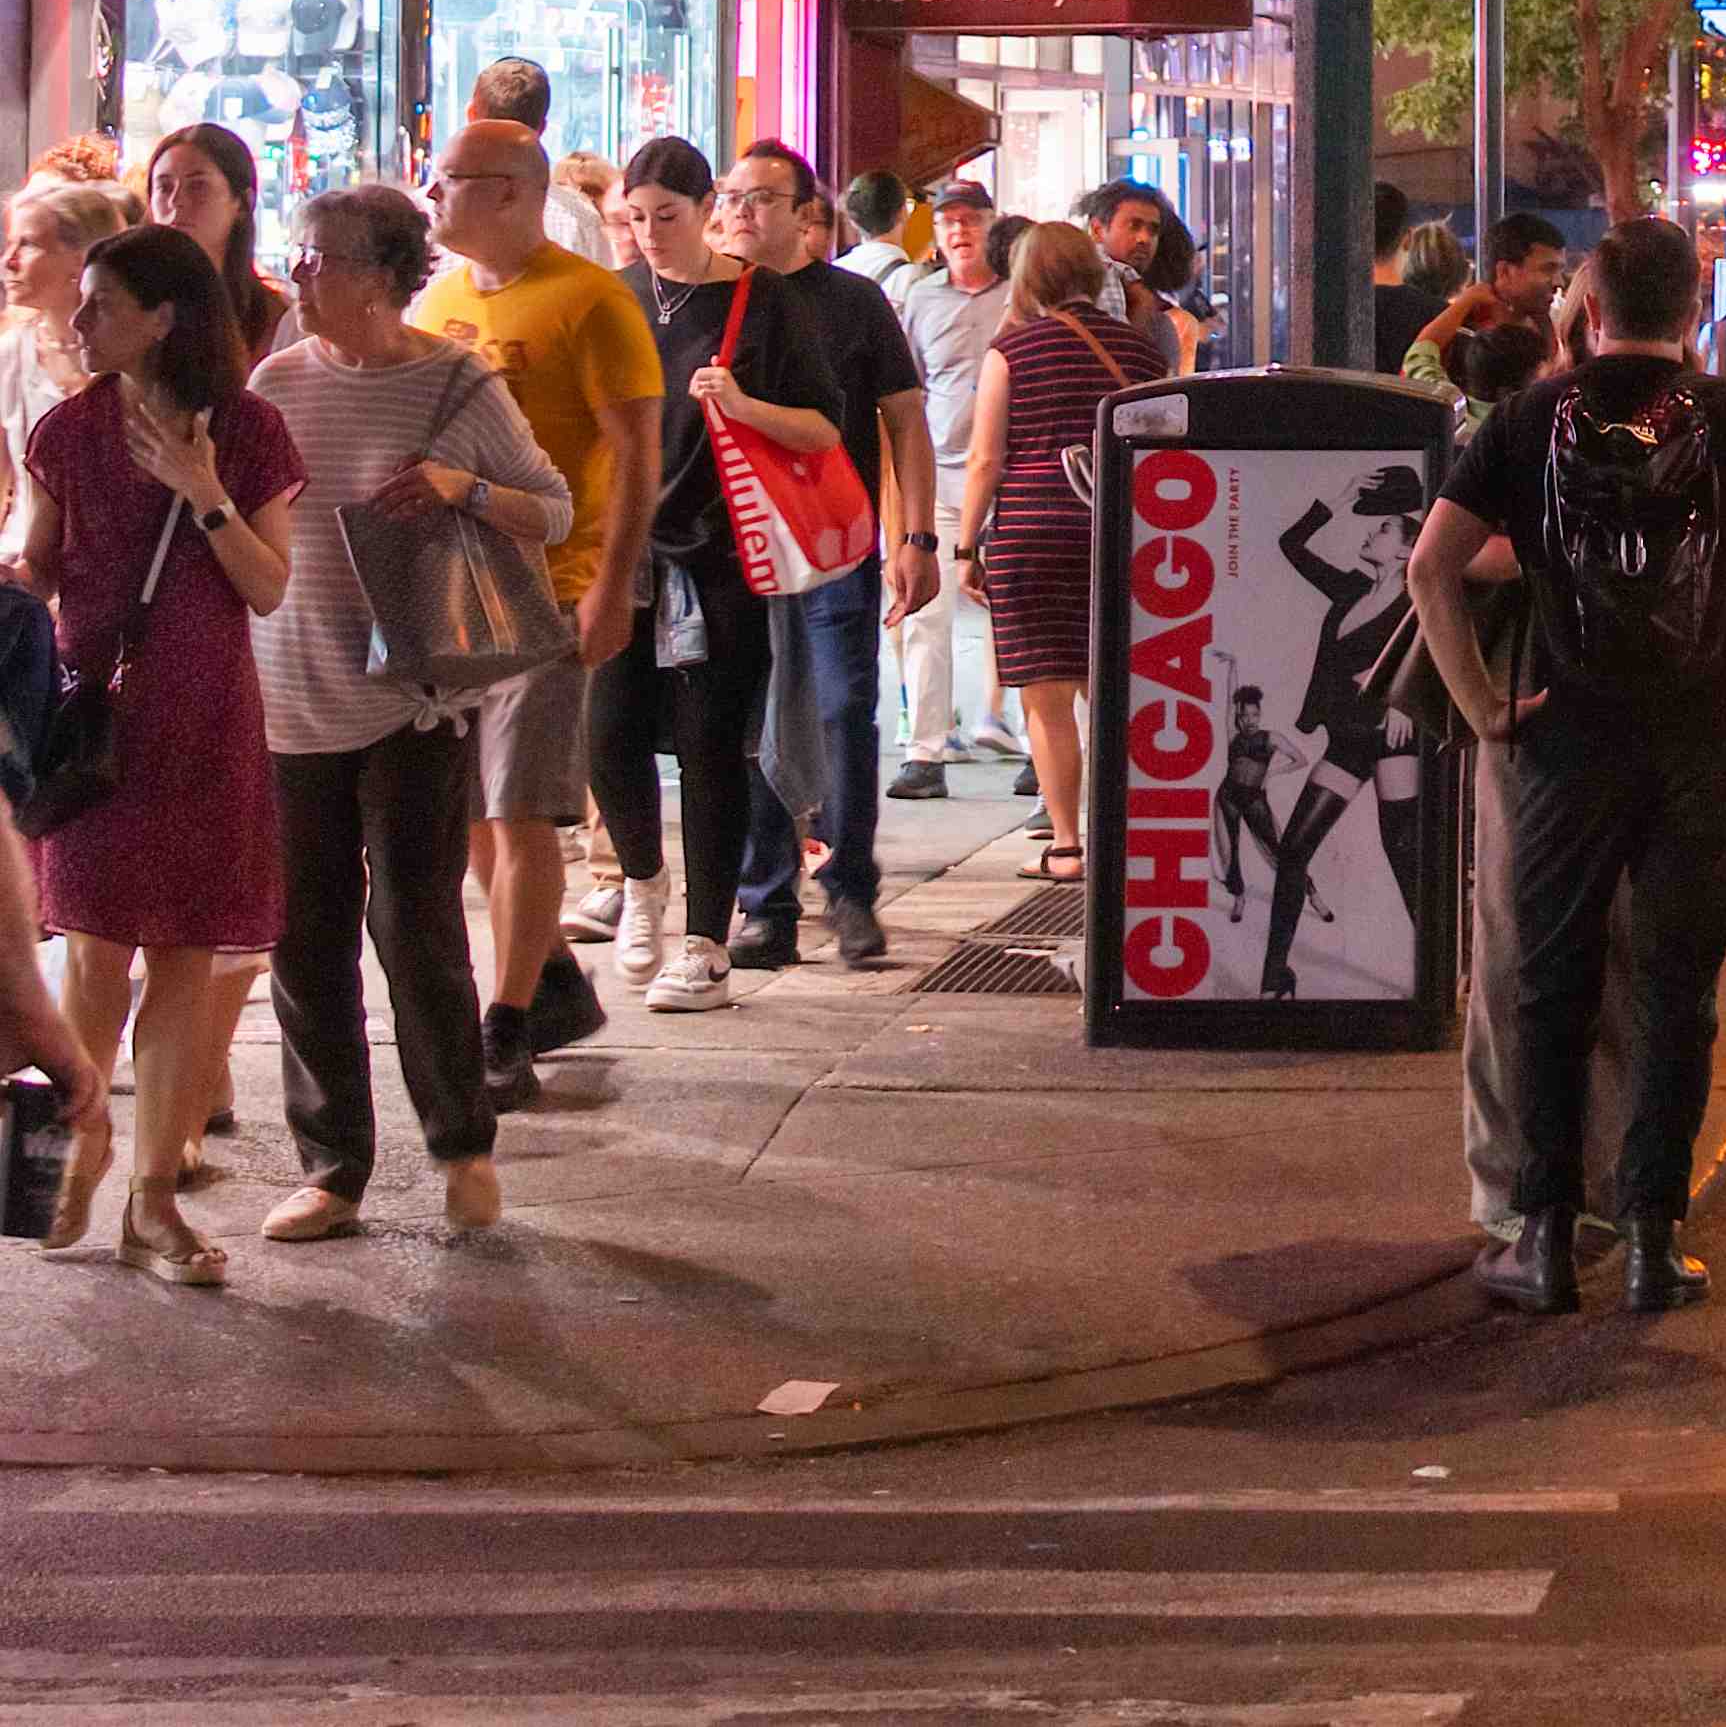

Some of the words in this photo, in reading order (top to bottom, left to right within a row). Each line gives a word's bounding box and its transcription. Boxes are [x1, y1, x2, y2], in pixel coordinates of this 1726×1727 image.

[1228, 467, 1241, 509] PARTY
[1229, 514, 1240, 544] THE
[1229, 552, 1240, 579] JOIN
[1122, 449, 1218, 1000] CHICAGO
